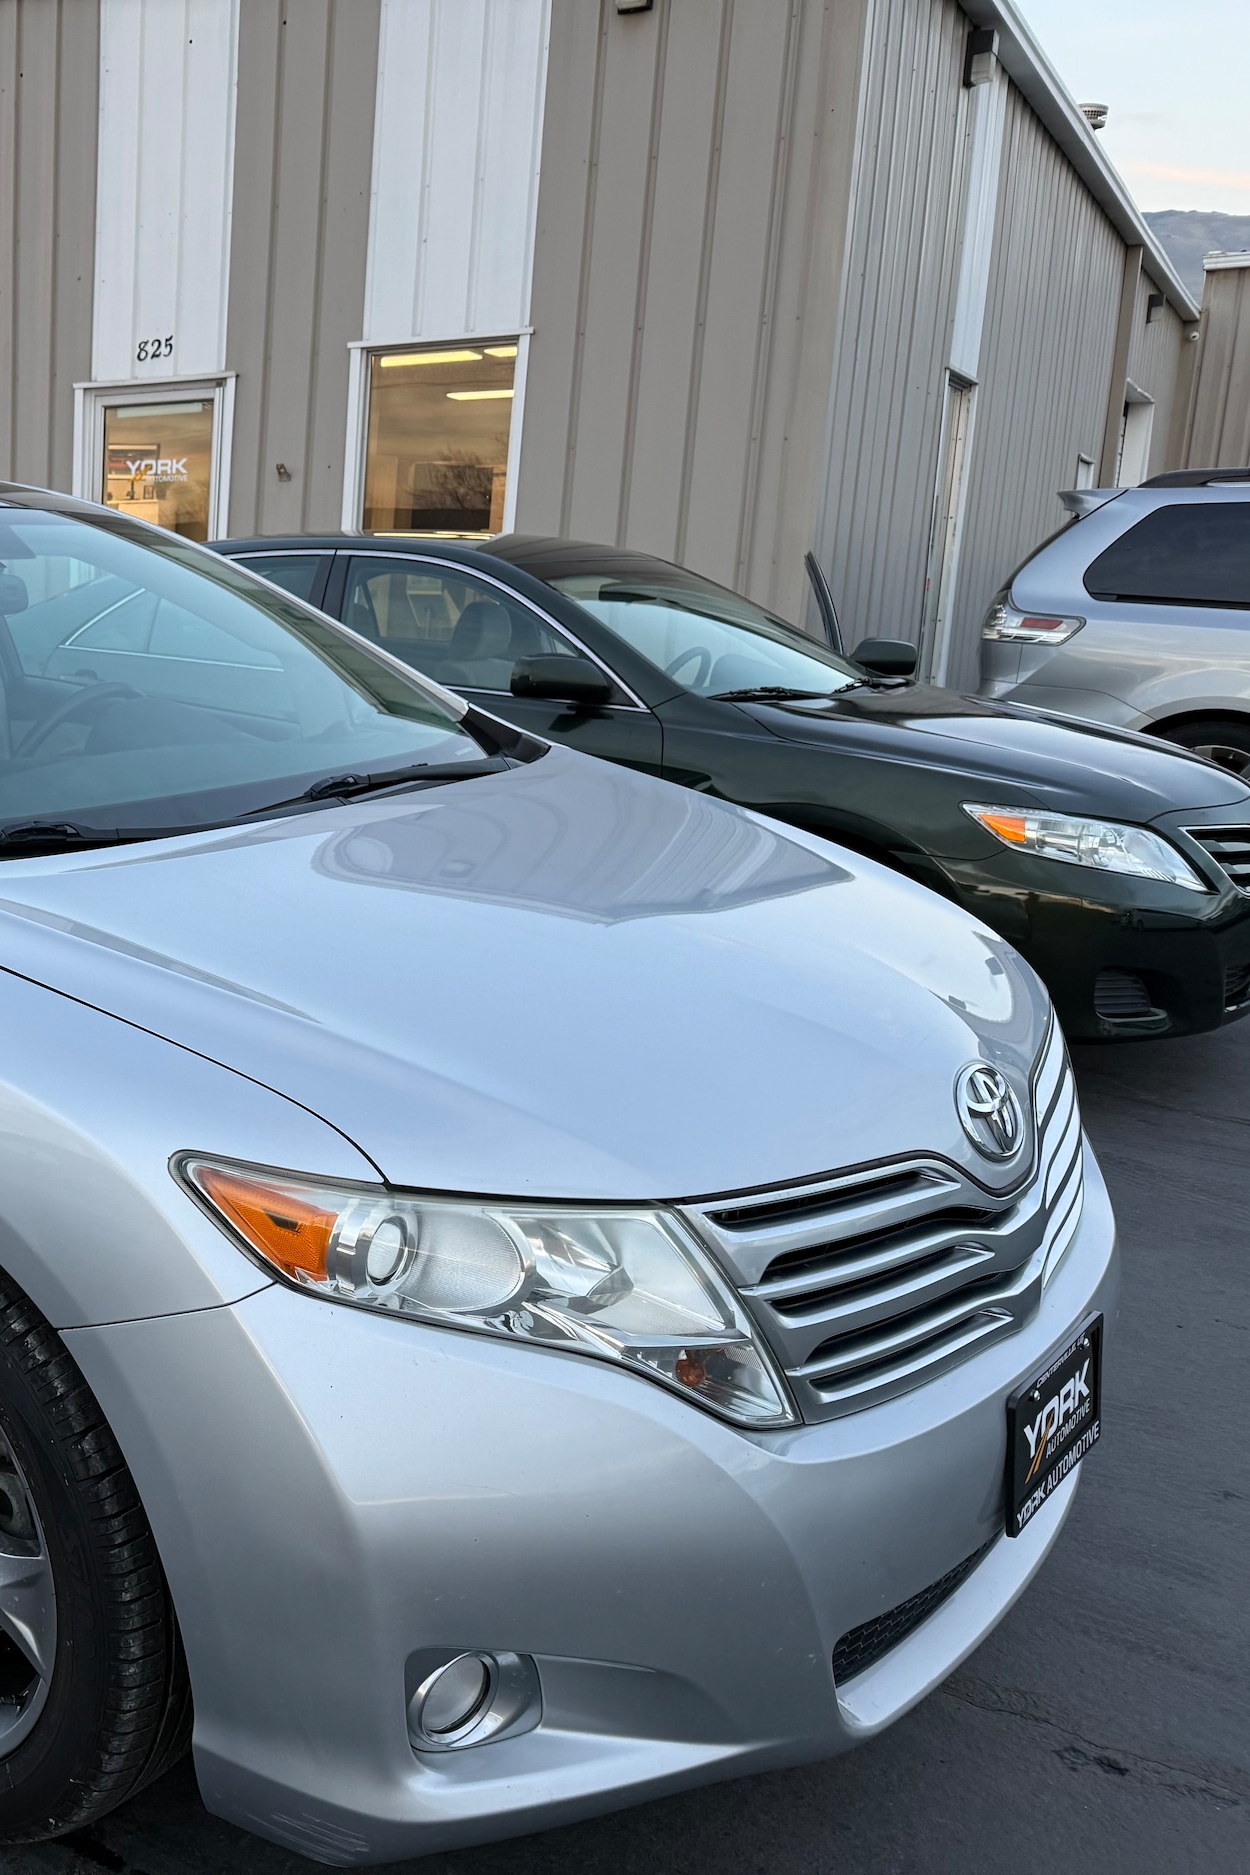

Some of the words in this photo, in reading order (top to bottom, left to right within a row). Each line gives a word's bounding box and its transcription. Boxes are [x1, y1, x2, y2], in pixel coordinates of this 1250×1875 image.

[136, 335, 173, 361] 825
[125, 457, 188, 476] YORK
[1023, 1357, 1091, 1459] YORK
[1045, 1398, 1091, 1459] AUTOMOTIVE
[1016, 1481, 1046, 1529] YORK
[1046, 1420, 1100, 1495] AUTOMOTIVE
